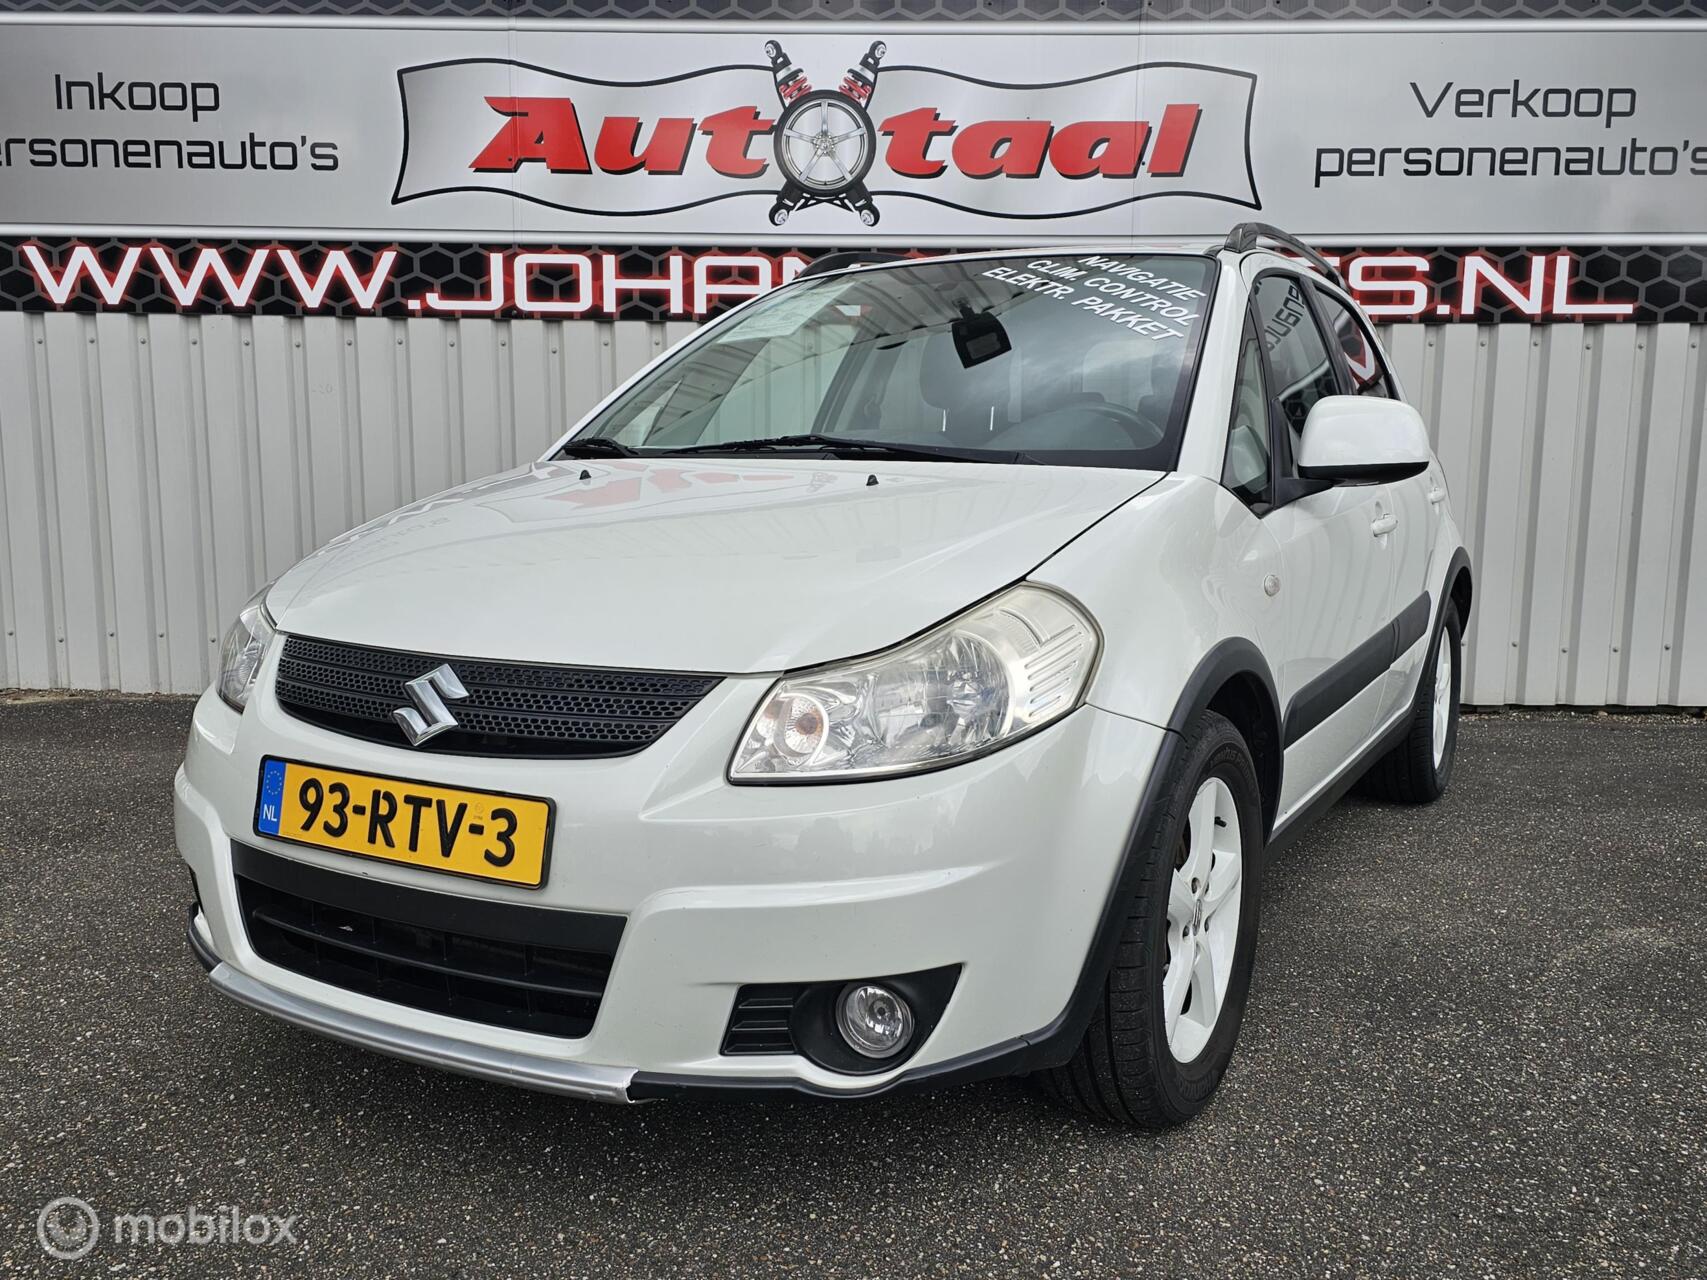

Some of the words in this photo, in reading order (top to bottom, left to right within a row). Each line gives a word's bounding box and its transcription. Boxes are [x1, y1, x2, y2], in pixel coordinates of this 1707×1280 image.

[55, 72, 220, 122] Inkoop
[1409, 79, 1637, 128] Verkoop
[0, 132, 339, 171] rsonenauto's
[1314, 137, 1707, 188] personenauto's
[1026, 260, 1088, 281] CLIM.
[1083, 277, 1201, 326] CONTROL
[1077, 255, 1207, 301] NAVIGATIE
[1288, 255, 1634, 316] S.NL
[982, 266, 1076, 300] ELEKTR.
[1071, 296, 1184, 341] PAKKET
[262, 803, 278, 823] NL
[298, 777, 518, 868] 93-RTV-3
